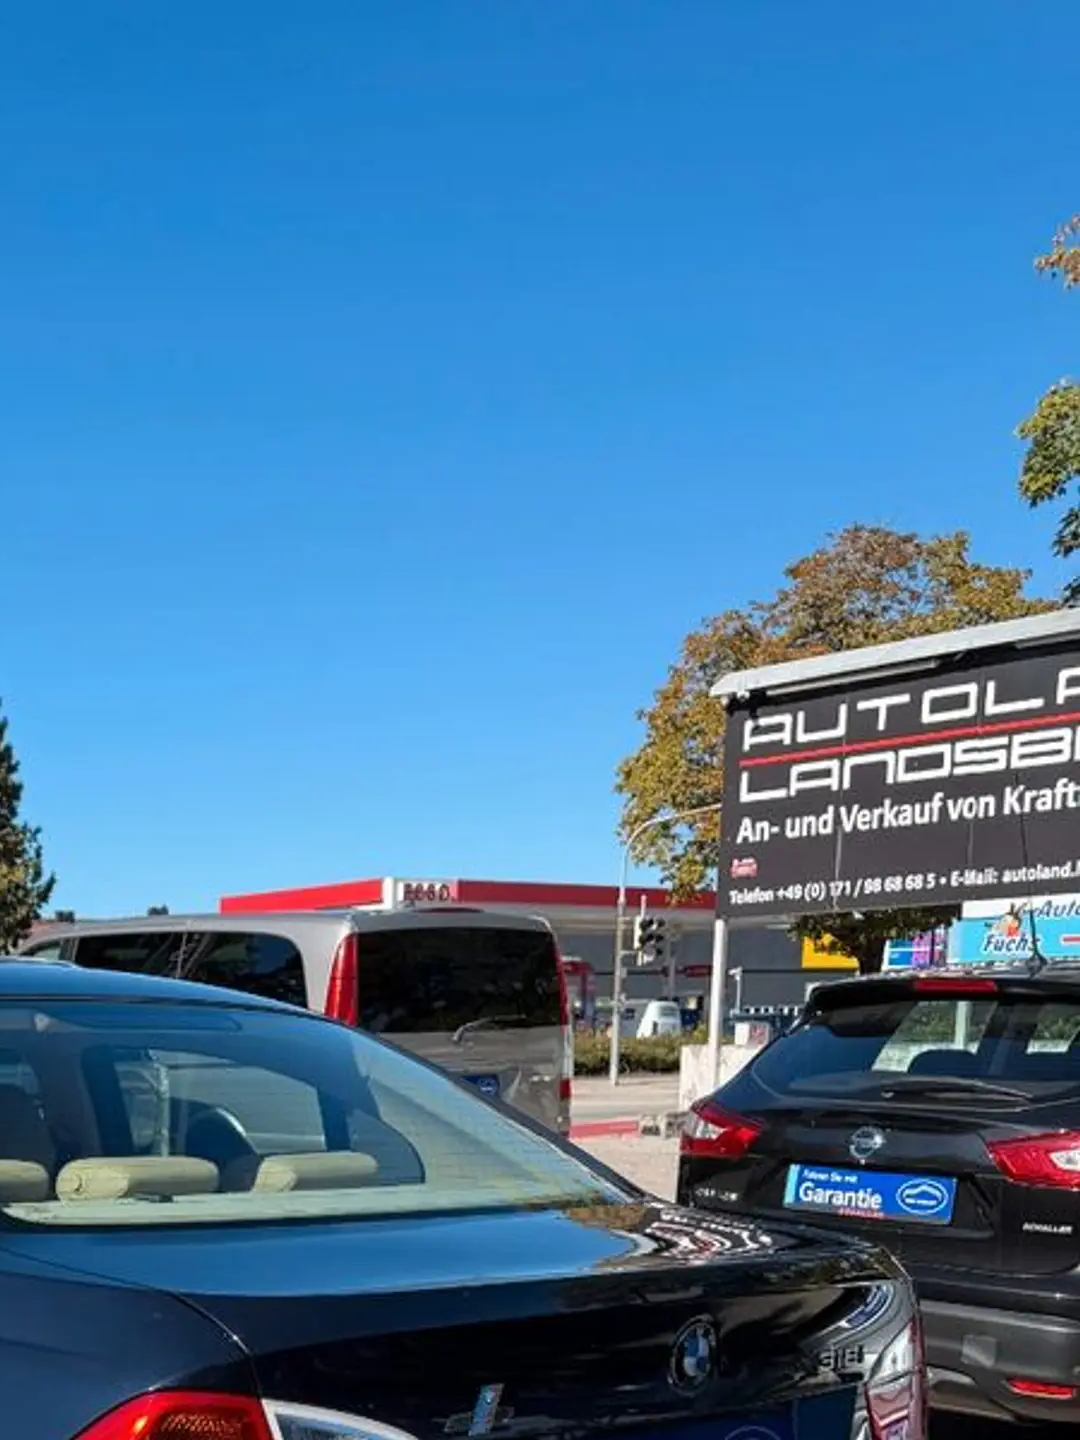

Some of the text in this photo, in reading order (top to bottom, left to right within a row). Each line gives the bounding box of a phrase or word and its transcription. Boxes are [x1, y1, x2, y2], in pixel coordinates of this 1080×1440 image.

[739, 726, 1080, 803] LANDSB
[736, 816, 780, 844] An-
[785, 805, 834, 838] und
[839, 791, 944, 833] Verkauf
[947, 794, 995, 822] von
[729, 886, 774, 904] Telefon
[777, 884, 803, 899] +49
[829, 880, 851, 897] 171
[905, 873, 924, 891] 68
[926, 871, 937, 889] 5
[950, 867, 999, 887] E-Mail:
[799, 1181, 882, 1210] Garantie
